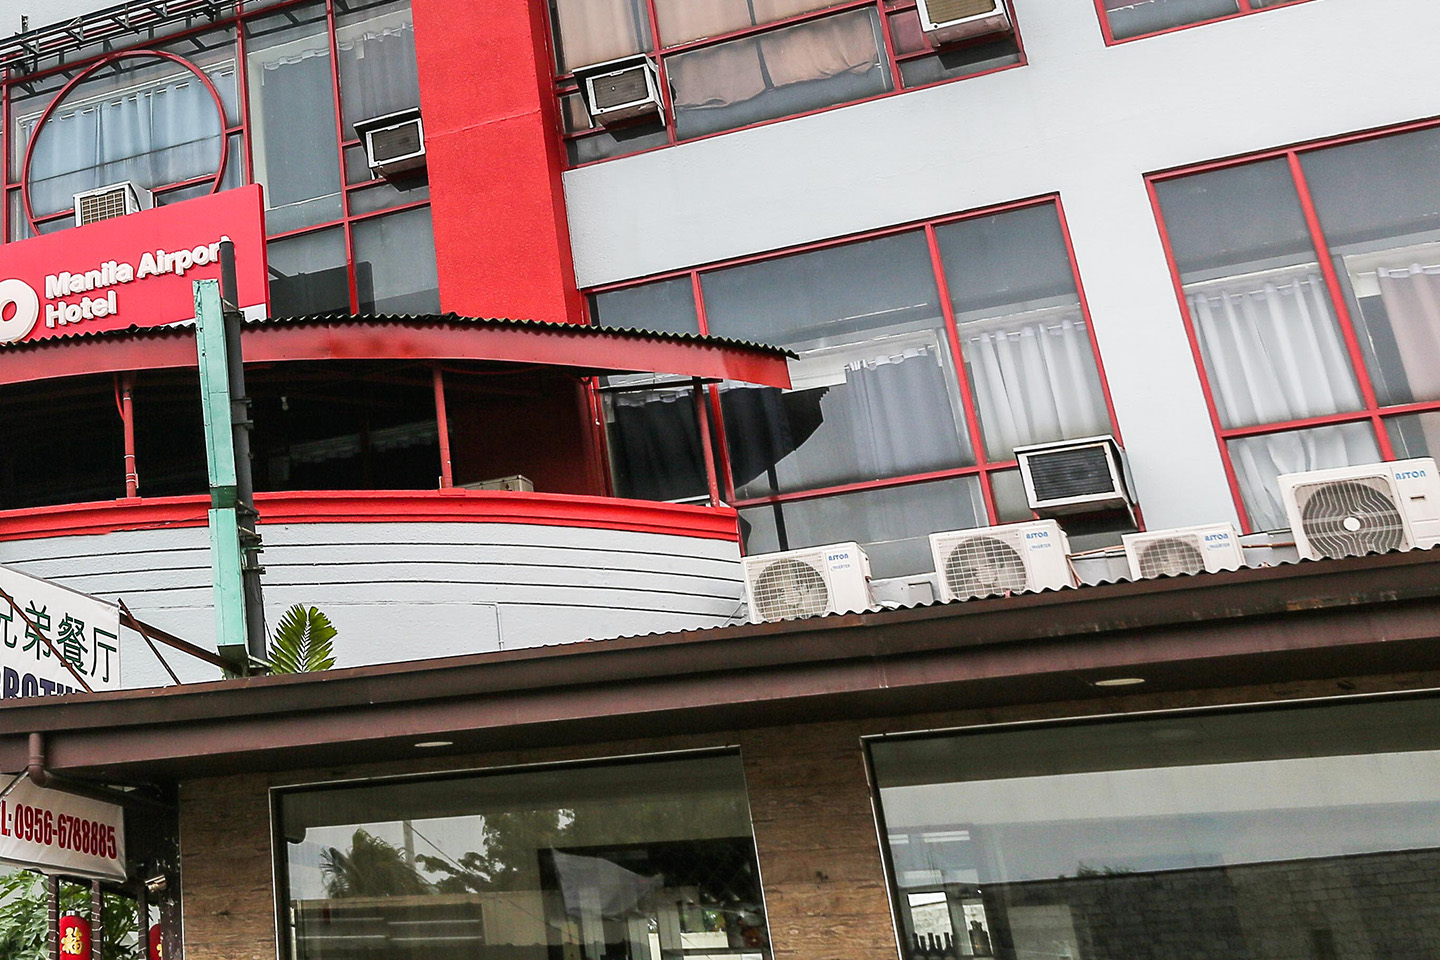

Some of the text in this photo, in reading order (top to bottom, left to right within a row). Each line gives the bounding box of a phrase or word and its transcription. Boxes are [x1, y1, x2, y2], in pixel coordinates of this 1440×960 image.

[45, 260, 134, 300] Manila
[45, 291, 118, 329] Hotel
[14, 803, 118, 860] 0956-6788885
